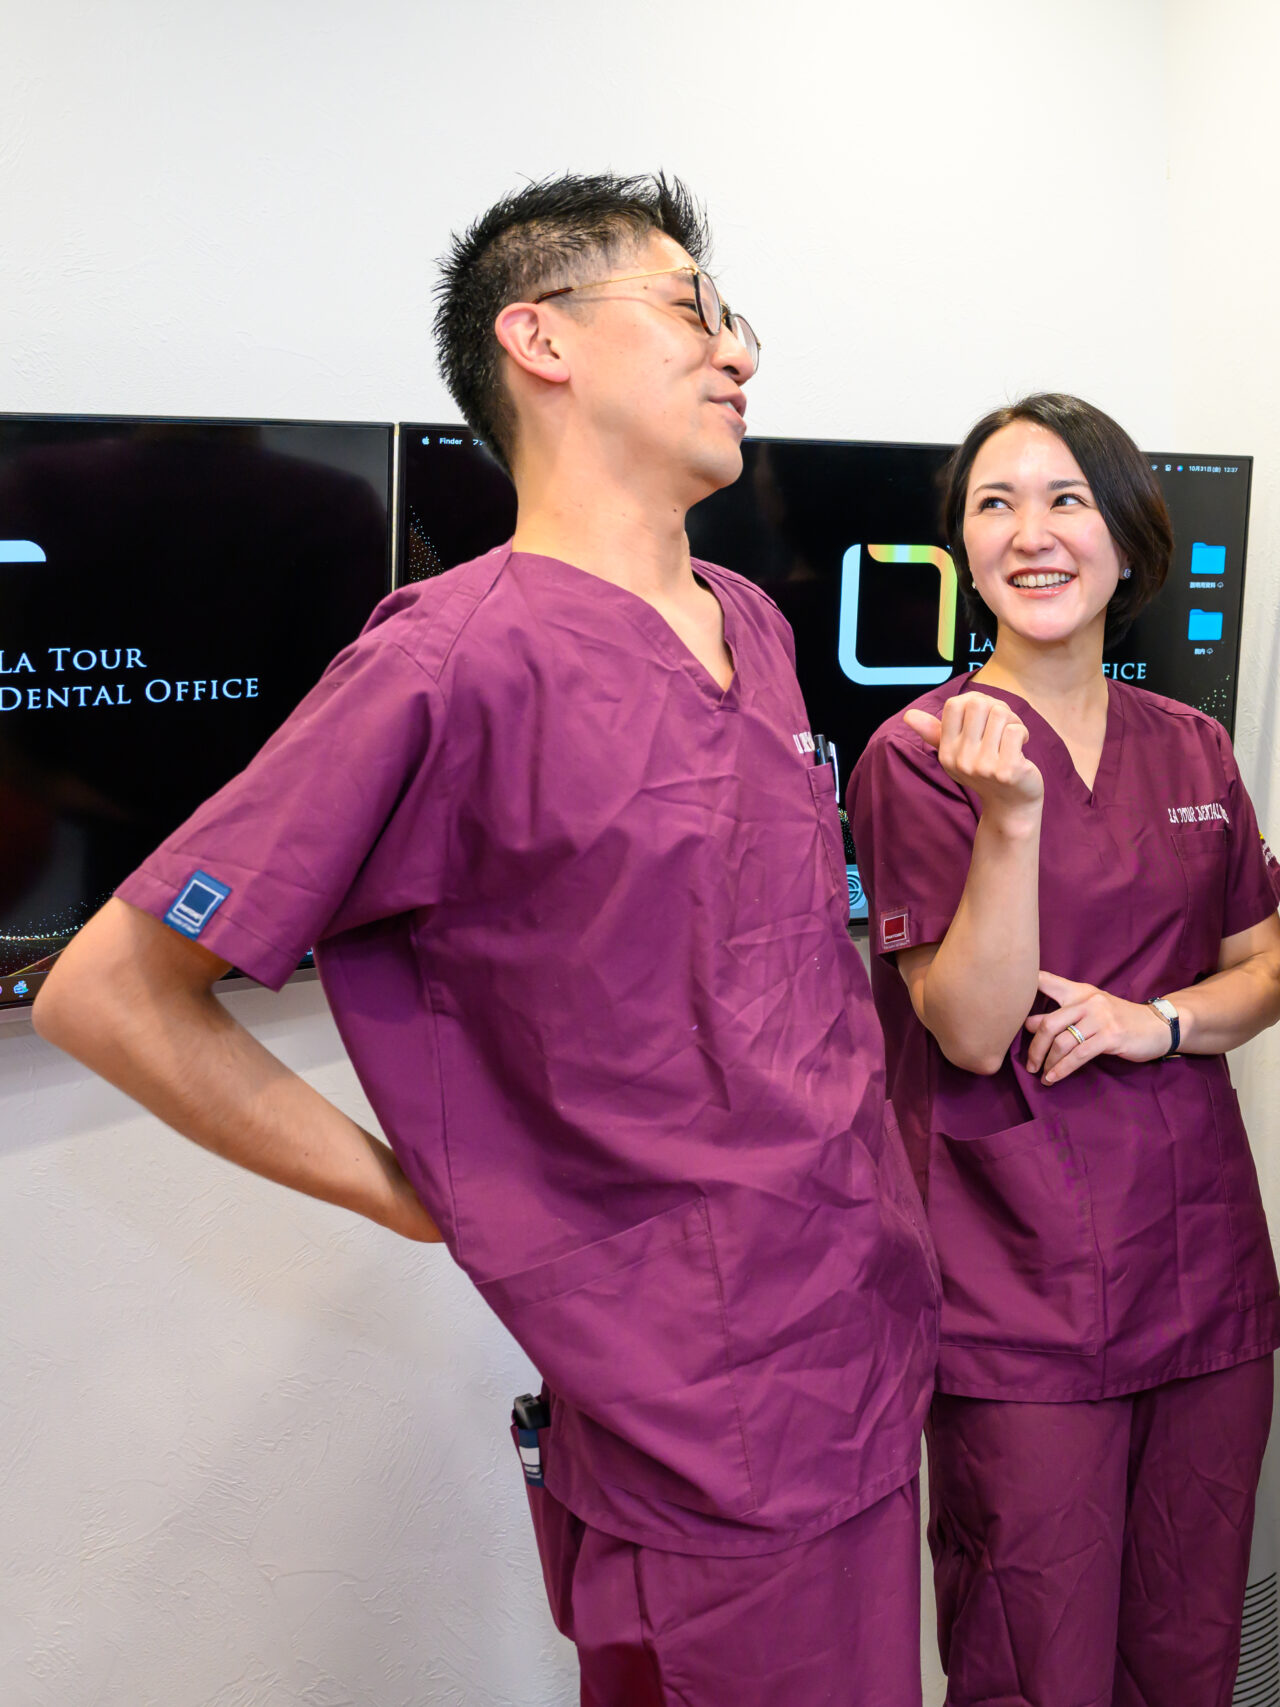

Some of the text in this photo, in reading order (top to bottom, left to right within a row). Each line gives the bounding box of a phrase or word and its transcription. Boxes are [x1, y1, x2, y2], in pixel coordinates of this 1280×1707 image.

[439, 437, 463, 445] Finder
[969, 632, 996, 653] LA
[0, 647, 147, 674] LA TOUR
[1102, 662, 1147, 680] FICE
[0, 678, 259, 712] DENTAL OFFICE
[1168, 807, 1179, 824] LA
